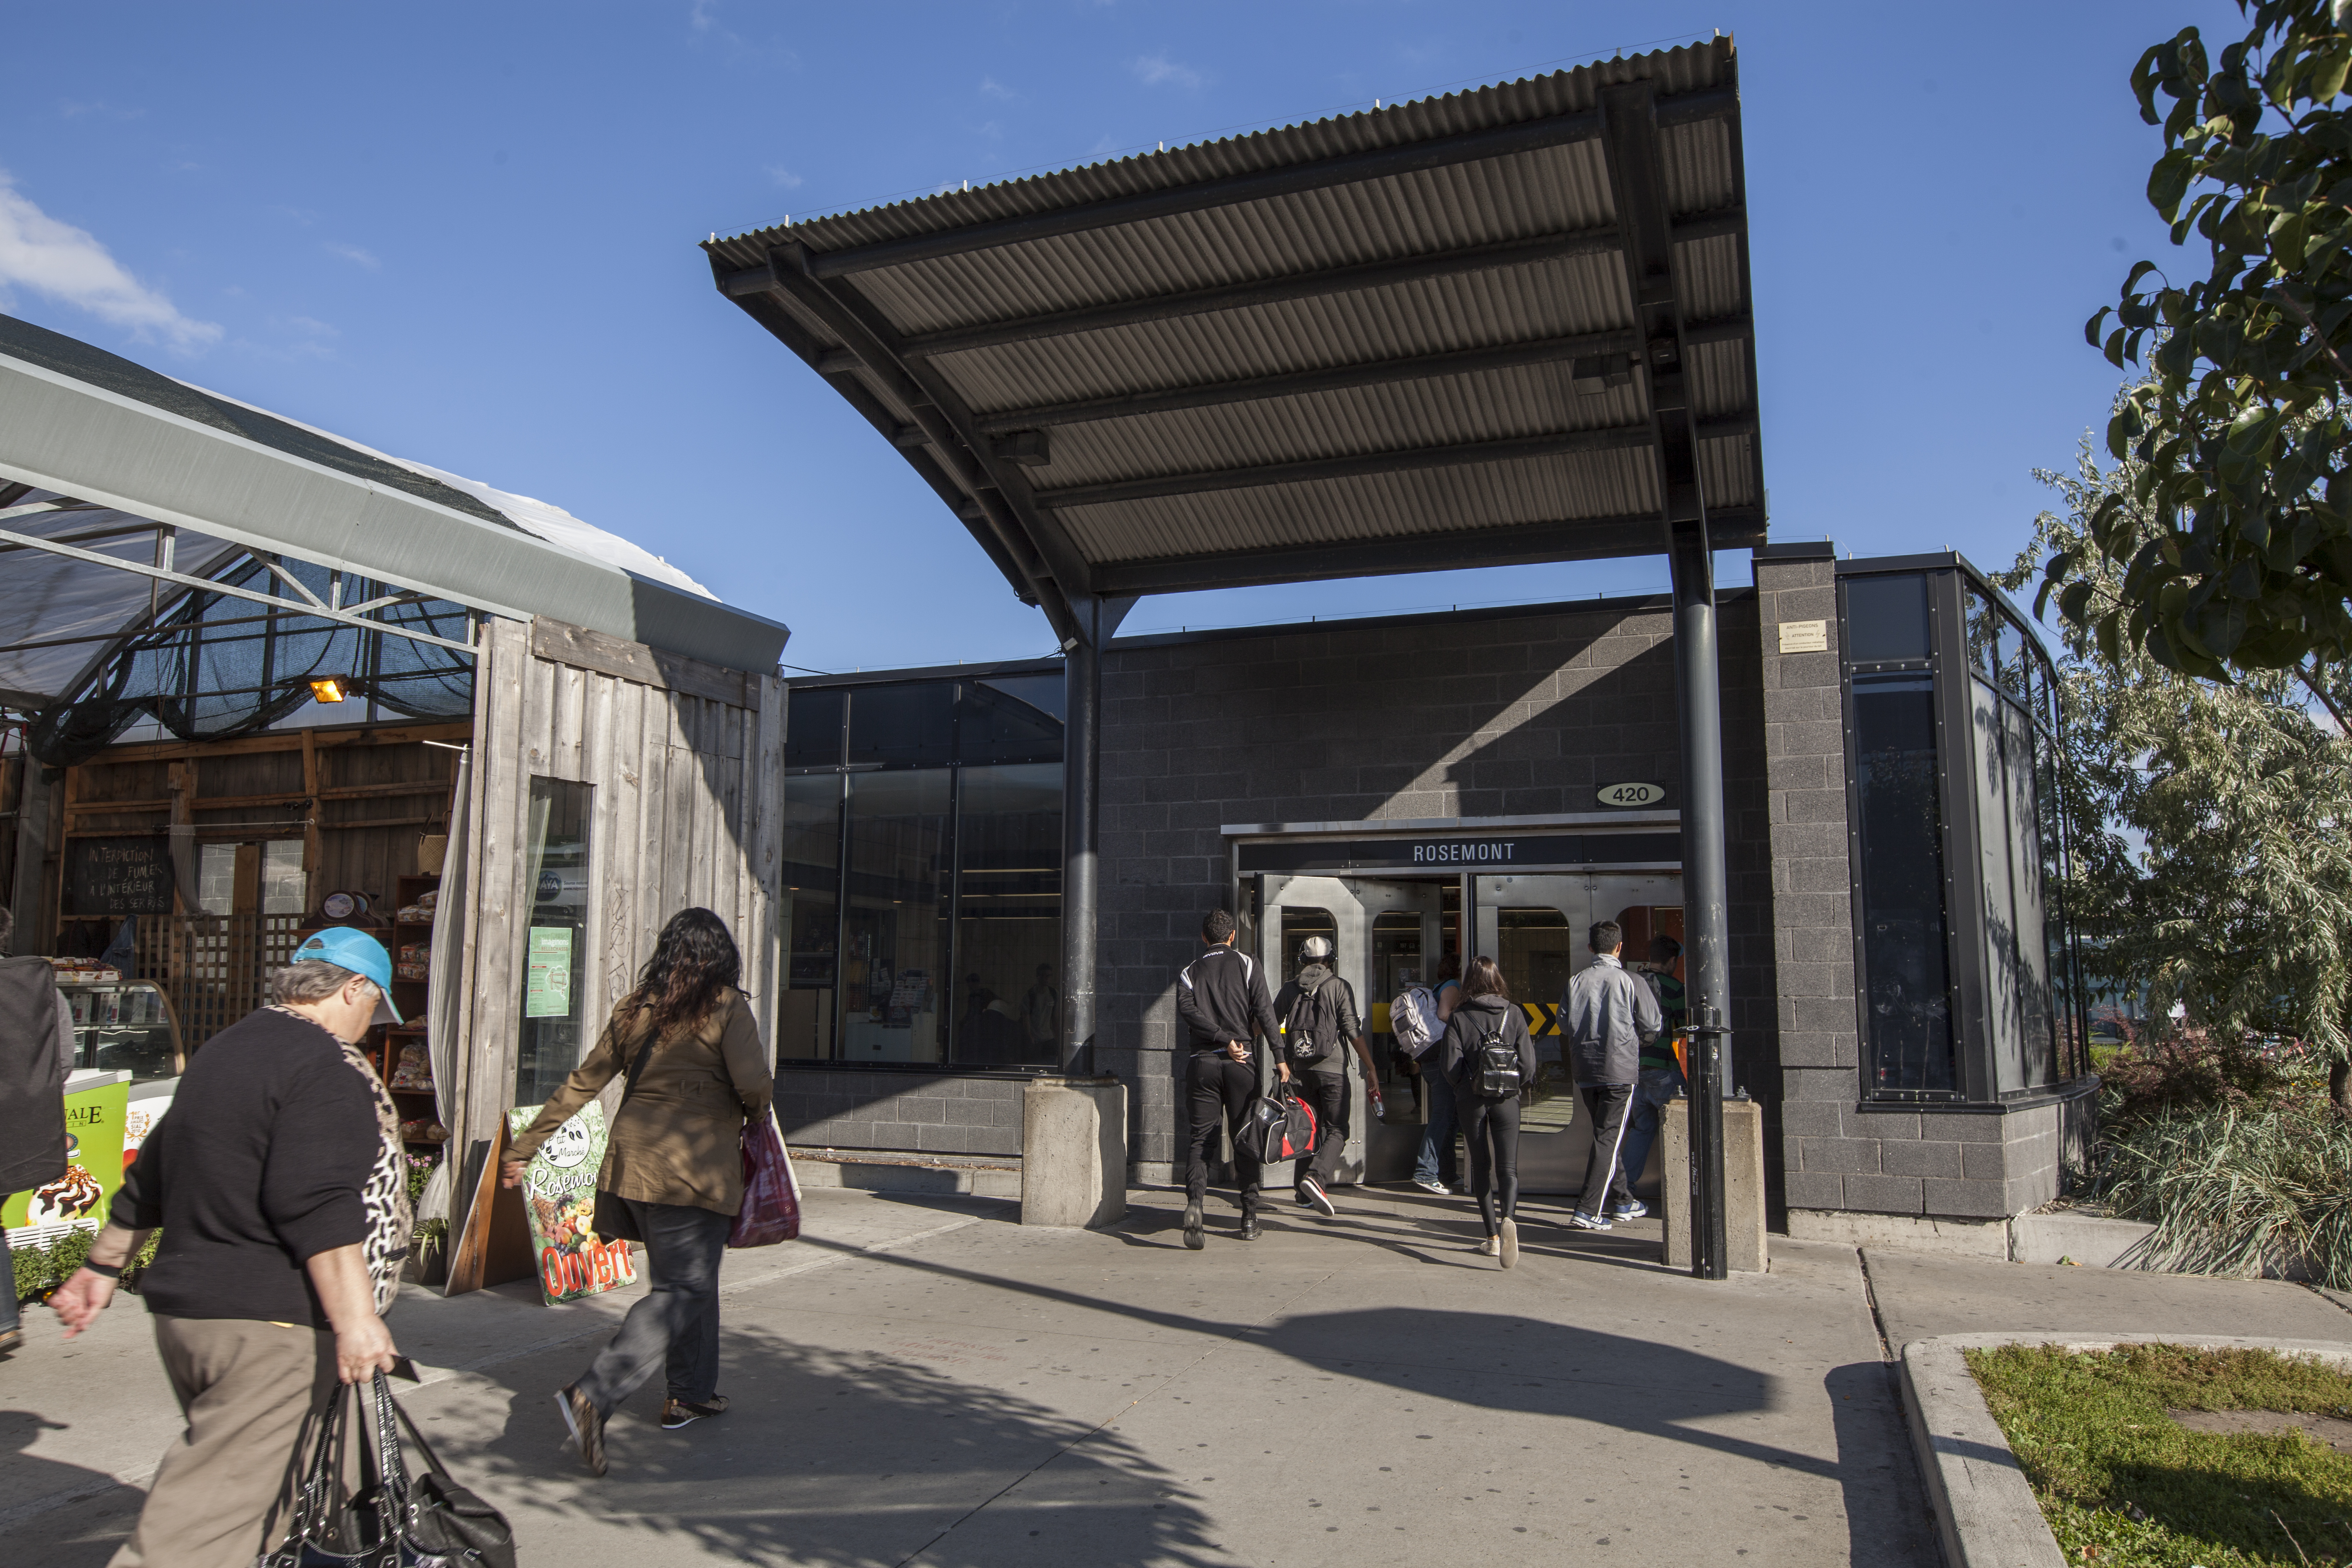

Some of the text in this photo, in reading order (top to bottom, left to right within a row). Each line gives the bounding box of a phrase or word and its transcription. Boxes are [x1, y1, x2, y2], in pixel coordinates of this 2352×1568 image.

[1613, 787, 1649, 802] 420
[89, 846, 154, 864] INTERDICTION
[1414, 843, 1514, 861] ROSEMONT
[108, 867, 119, 879] DE
[100, 878, 155, 896] L'INTÉRIEUR
[110, 897, 125, 909] DES
[541, 938, 569, 947] imaginons
[548, 1135, 566, 1145] P'tit
[558, 1147, 585, 1158] Marché
[542, 1238, 633, 1297] Ouvert
